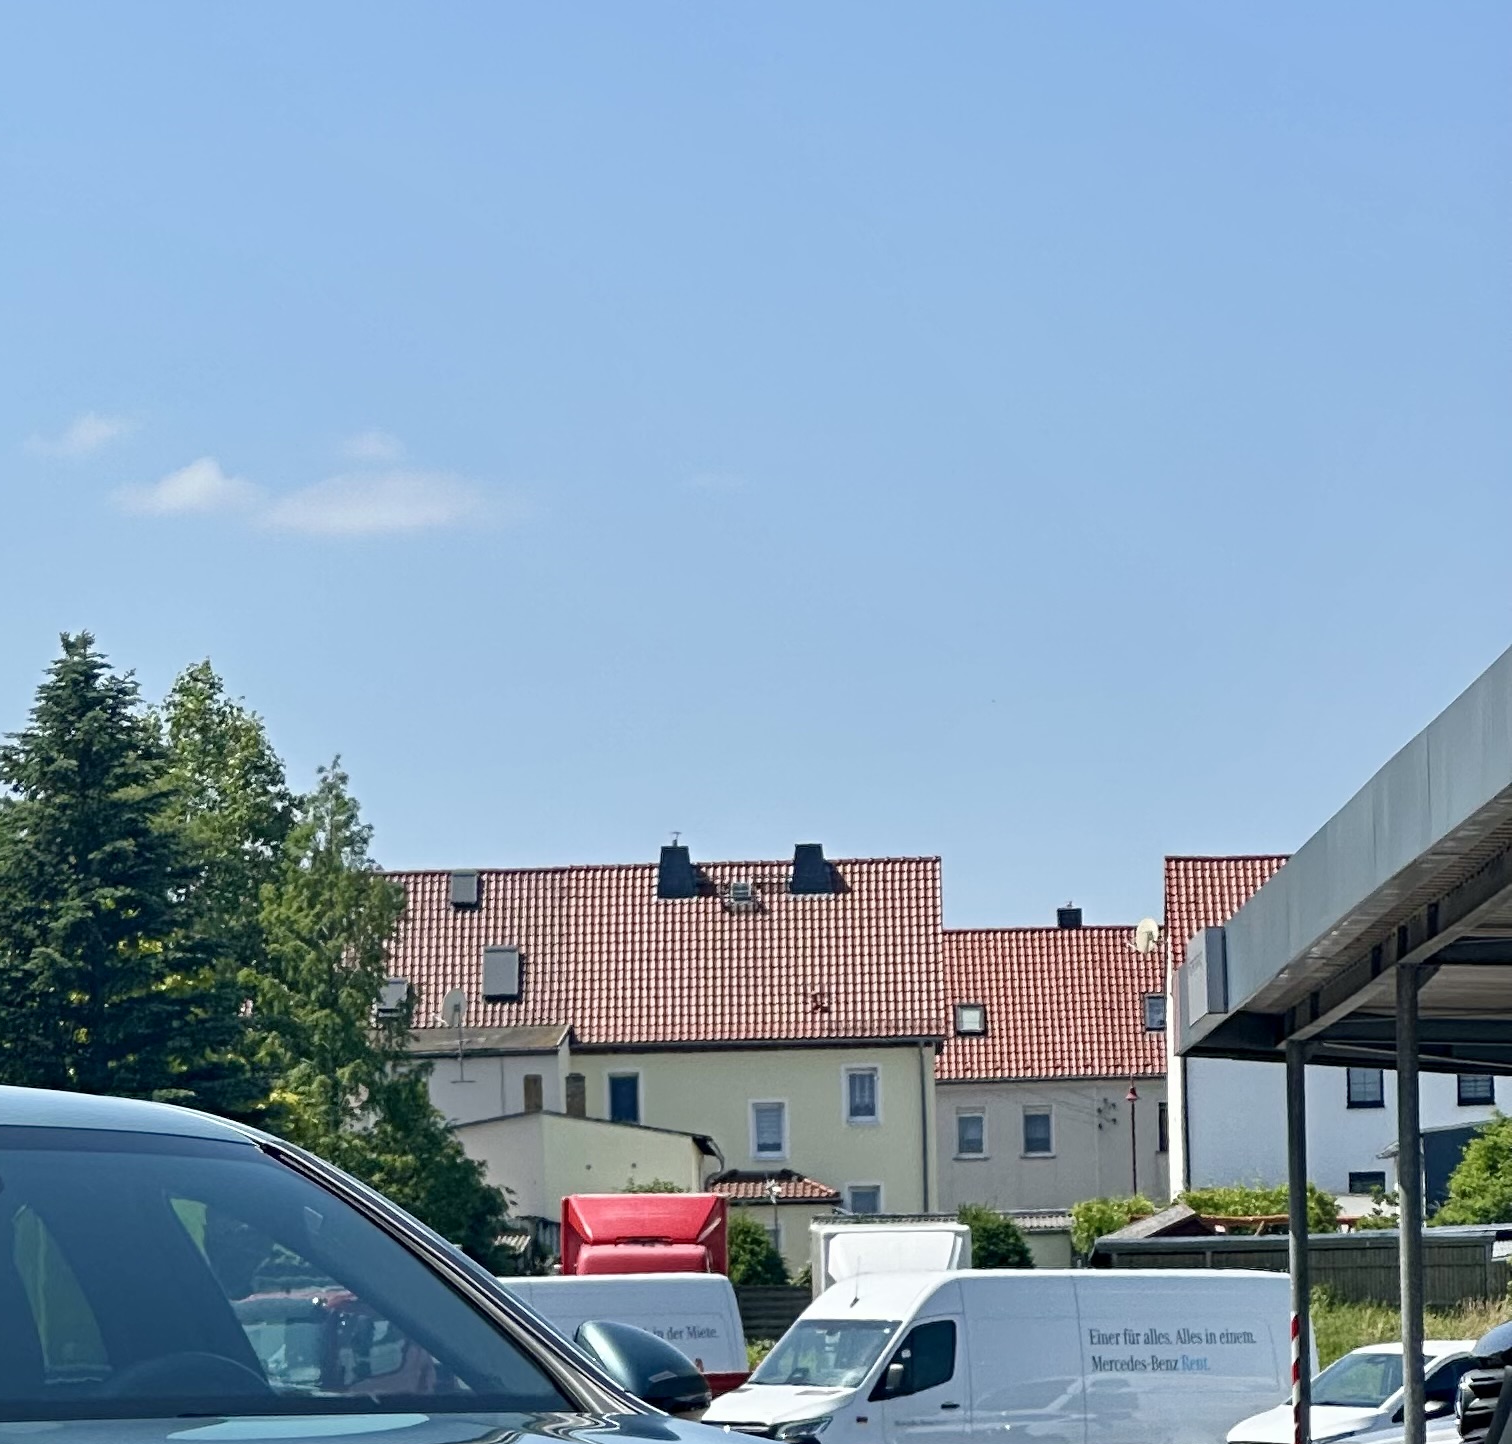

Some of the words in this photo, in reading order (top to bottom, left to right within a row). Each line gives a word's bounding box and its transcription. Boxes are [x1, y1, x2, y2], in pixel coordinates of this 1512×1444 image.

[668, 1326, 684, 1339] der
[686, 1326, 719, 1339] Miete.
[1088, 1328, 1120, 1345] Einer
[1123, 1328, 1141, 1345] für
[1143, 1328, 1173, 1345] alles.
[1175, 1327, 1203, 1345] Alles
[1205, 1328, 1217, 1344] in
[1219, 1328, 1257, 1344] einem.
[1091, 1355, 1179, 1372] Mercedes-Benz
[1180, 1355, 1211, 1372] Rent.
